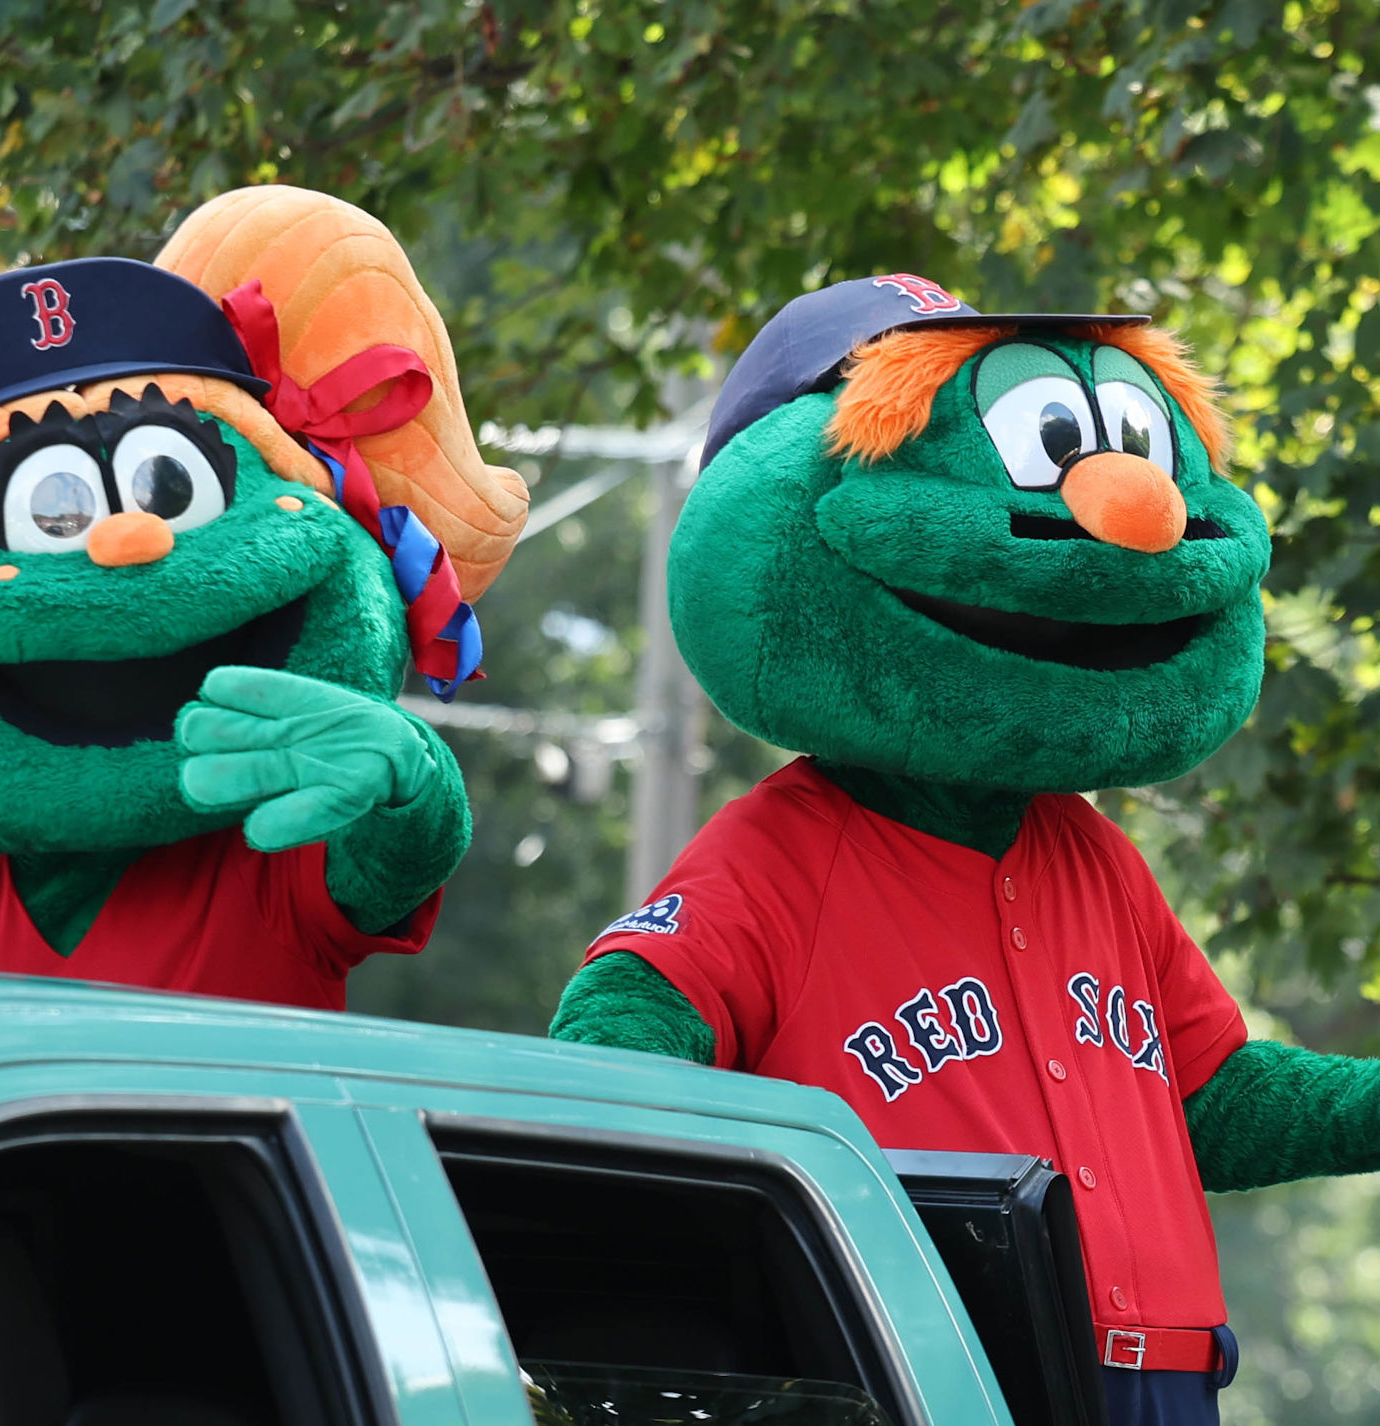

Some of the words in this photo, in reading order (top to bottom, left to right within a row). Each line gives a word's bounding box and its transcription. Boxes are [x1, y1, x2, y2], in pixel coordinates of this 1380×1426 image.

[21, 278, 76, 350] B
[872, 273, 962, 314] B
[843, 976, 1003, 1102] RED
[1067, 972, 1169, 1086] SOX
